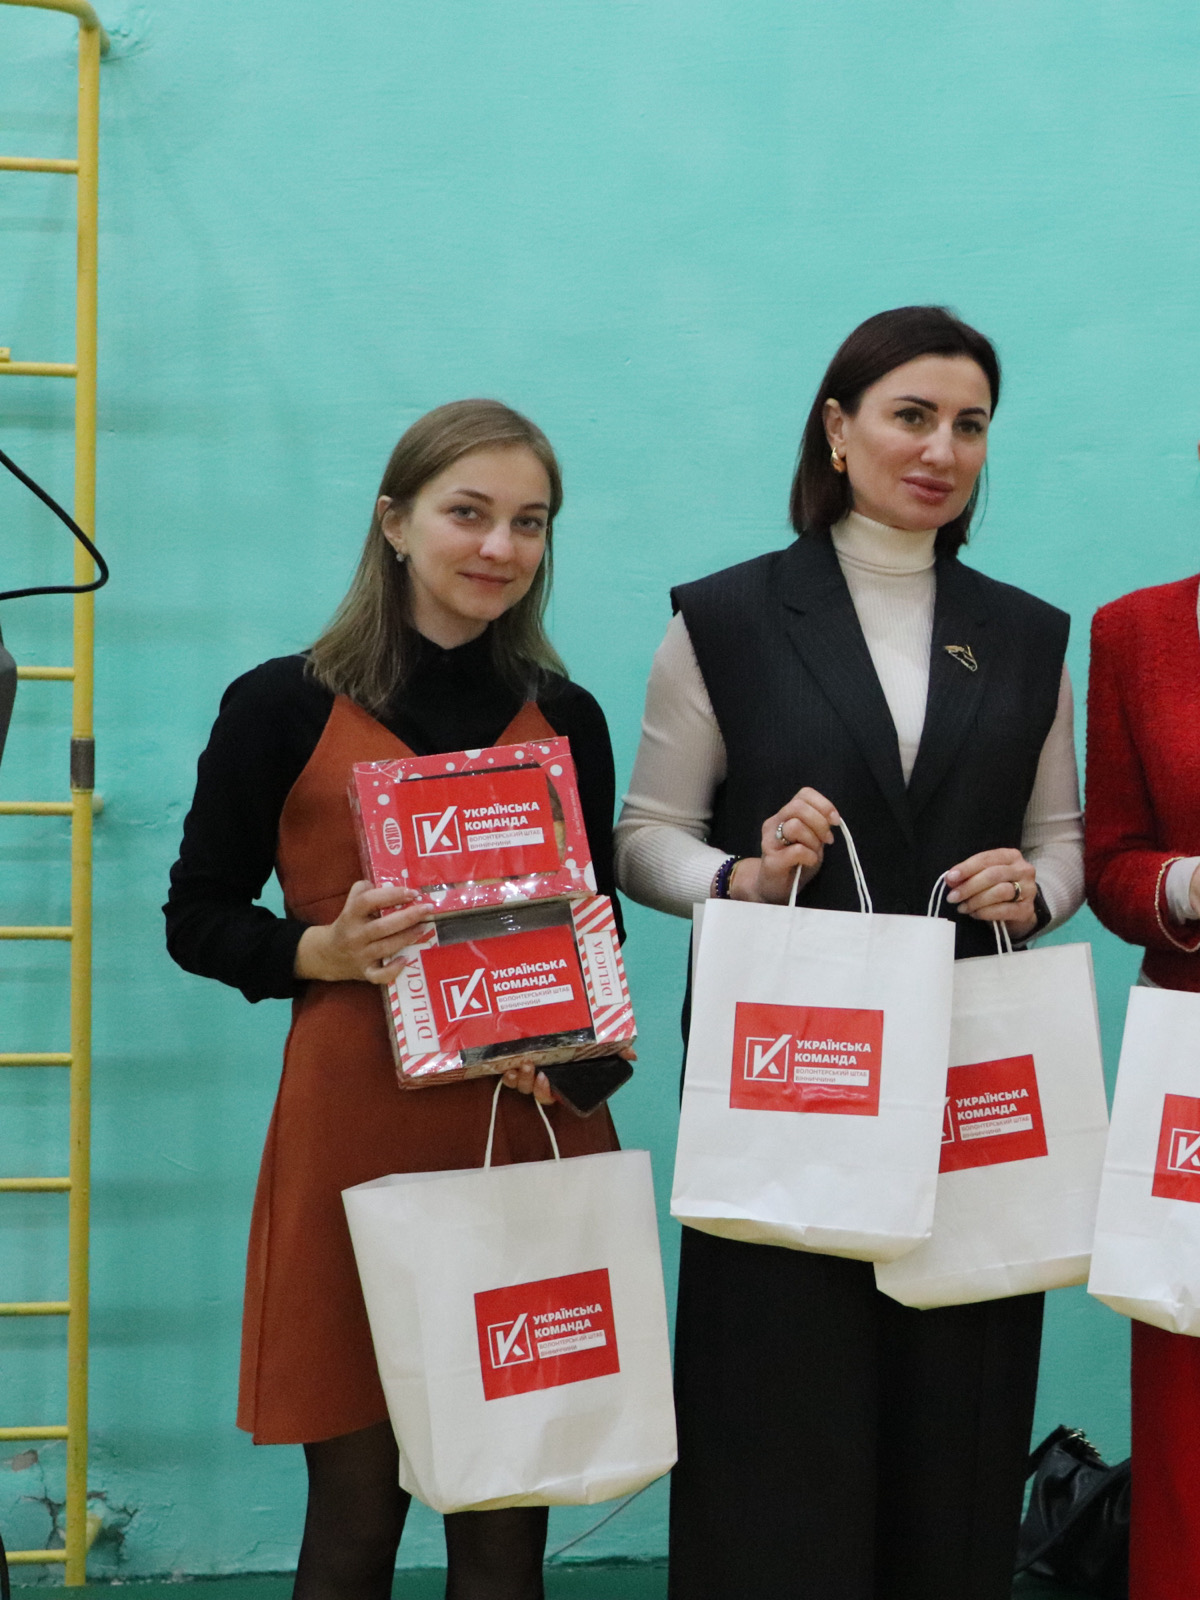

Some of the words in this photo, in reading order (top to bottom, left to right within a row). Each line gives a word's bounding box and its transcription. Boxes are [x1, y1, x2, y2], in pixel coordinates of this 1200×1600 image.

[463, 802, 540, 818] УКРАЇНСЬКА
[465, 816, 528, 831] КОМАНДА
[385, 823, 400, 850] LUKAS
[491, 959, 567, 979] УКРАЇНСЬКА
[593, 941, 612, 996] DELICIA
[493, 974, 556, 992] КОМАНДА
[405, 958, 433, 1040] DELICIA
[796, 1039, 871, 1052] УКРАЇНСЬКА
[795, 1053, 856, 1065] КОМАНДА
[956, 1089, 1028, 1108] УКРАЇНСЬКА
[957, 1103, 1017, 1120] КОМАНДА
[533, 1304, 602, 1325] УКРАЇНСЬКА
[534, 1319, 591, 1338] КОМАНДА
